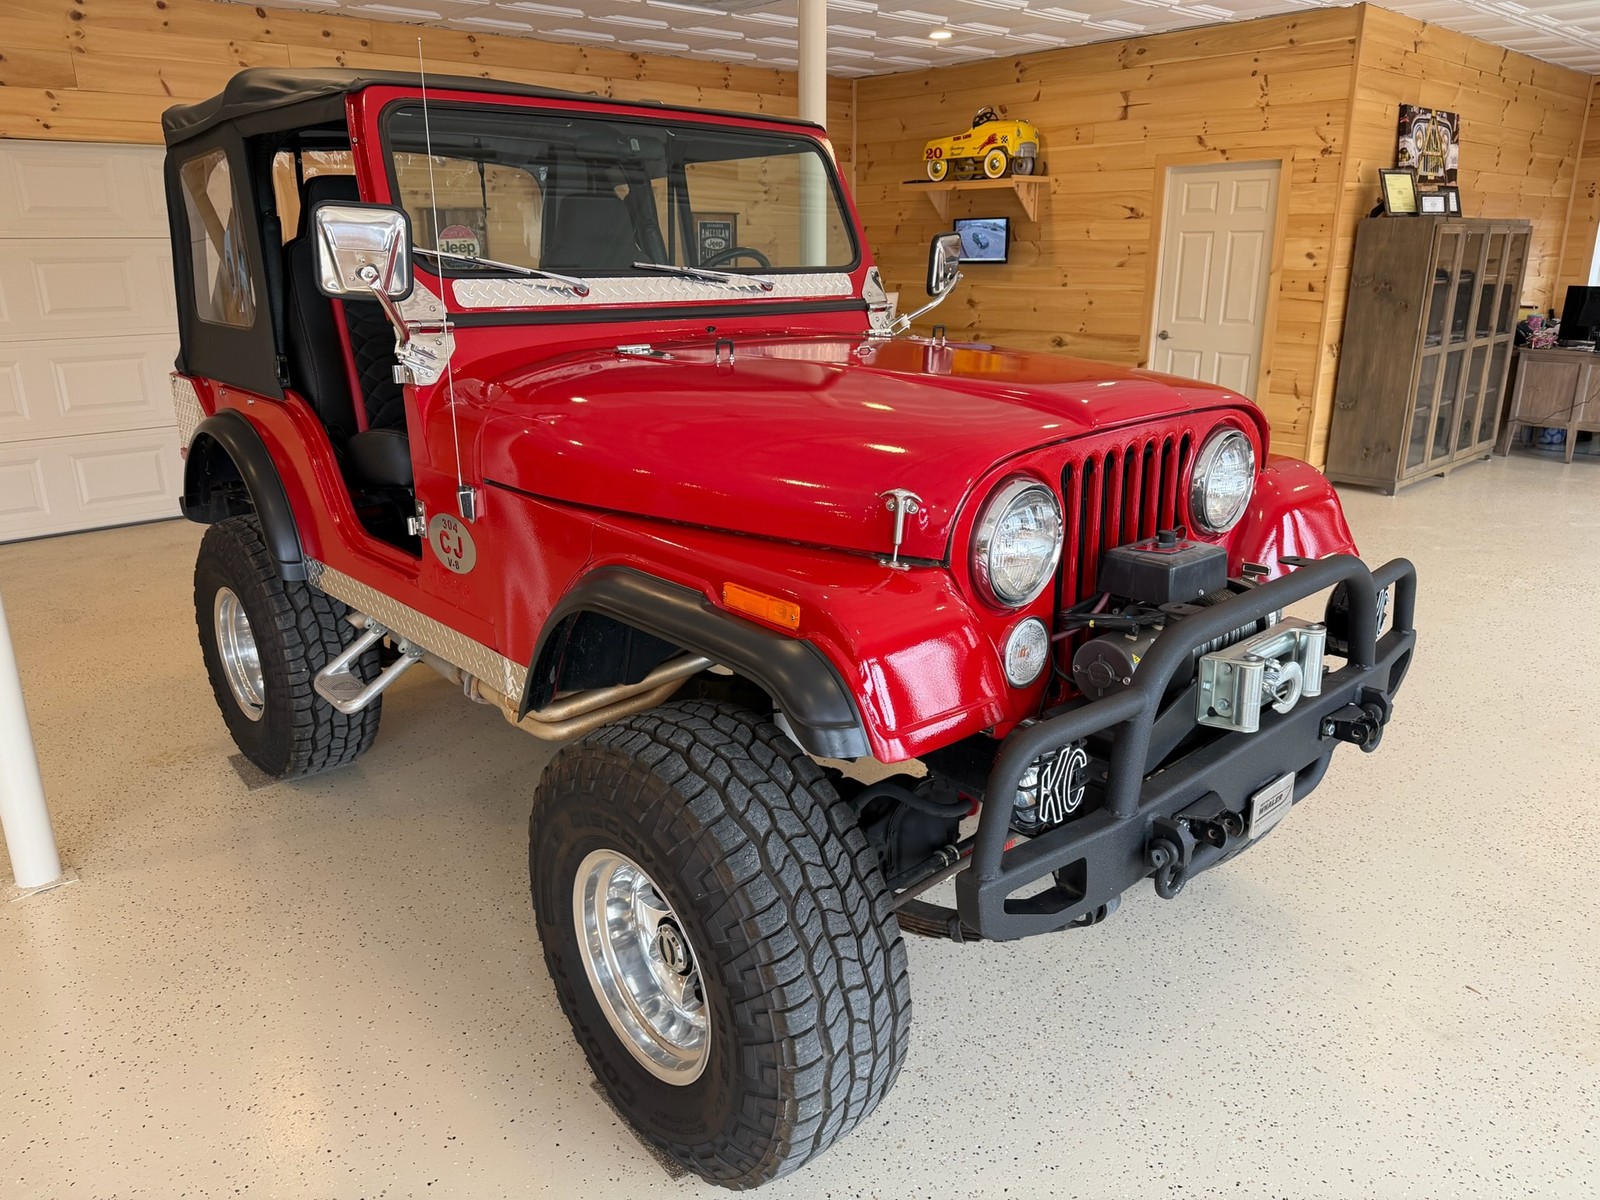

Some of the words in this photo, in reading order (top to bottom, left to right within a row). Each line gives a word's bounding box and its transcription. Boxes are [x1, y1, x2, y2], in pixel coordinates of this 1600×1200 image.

[926, 147, 943, 159] 20
[701, 229, 729, 239] AMERICAN
[442, 241, 475, 256] Jeep
[707, 239, 723, 248] Jeep
[441, 518, 459, 533] 304
[440, 530, 462, 559] CJ
[1039, 747, 1087, 824] KC
[1258, 793, 1284, 816] WHALER
[550, 951, 637, 1108] COOPER
